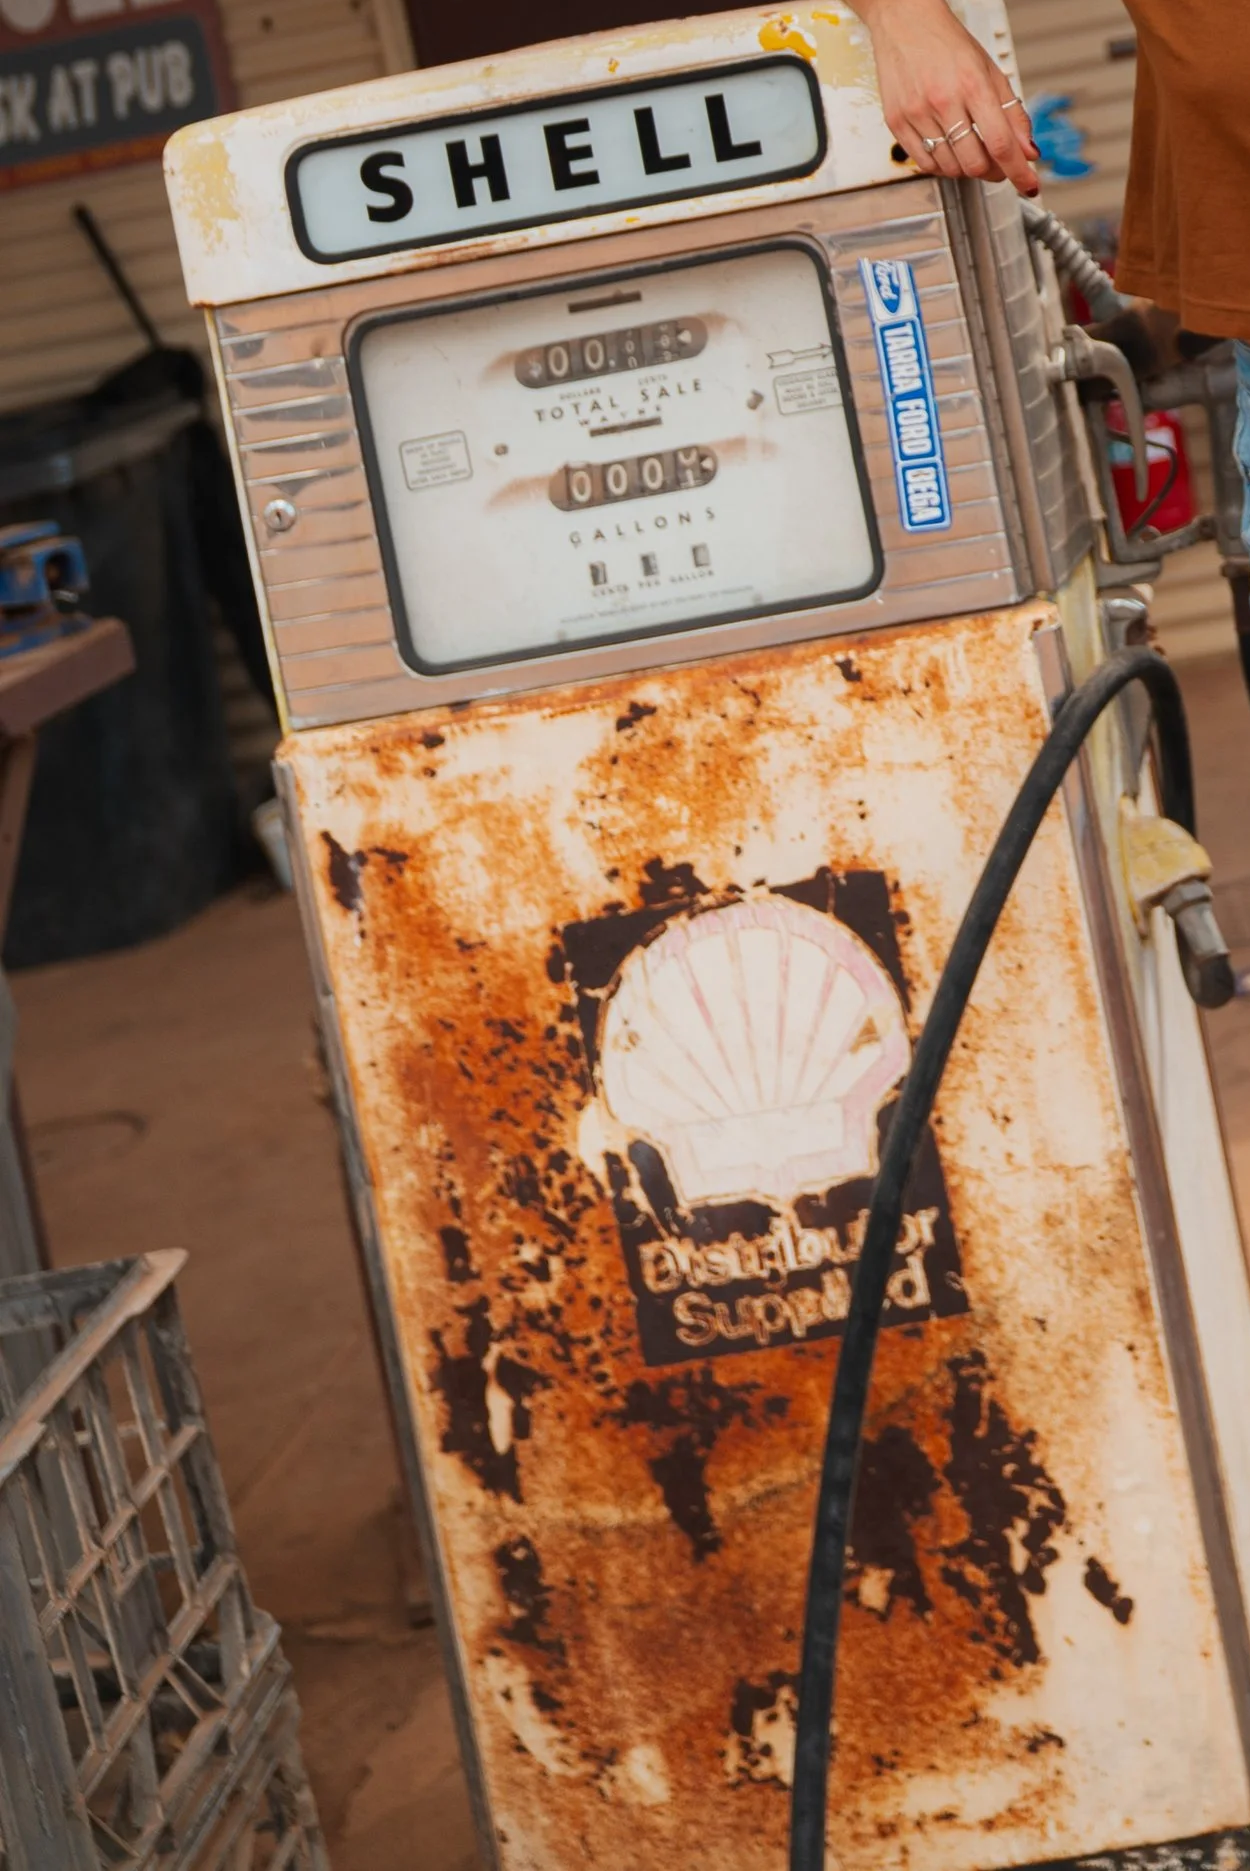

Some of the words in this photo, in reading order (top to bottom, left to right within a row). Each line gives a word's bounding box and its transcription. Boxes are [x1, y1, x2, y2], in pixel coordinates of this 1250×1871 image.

[47, 58, 99, 134] AT
[106, 39, 193, 120] PUB
[360, 93, 762, 223] SHELL
[884, 321, 923, 395] TARRA
[534, 396, 619, 422] TOTAL
[640, 378, 702, 402] SALE
[895, 397, 933, 456] FORD
[570, 507, 715, 547] GALLONS
